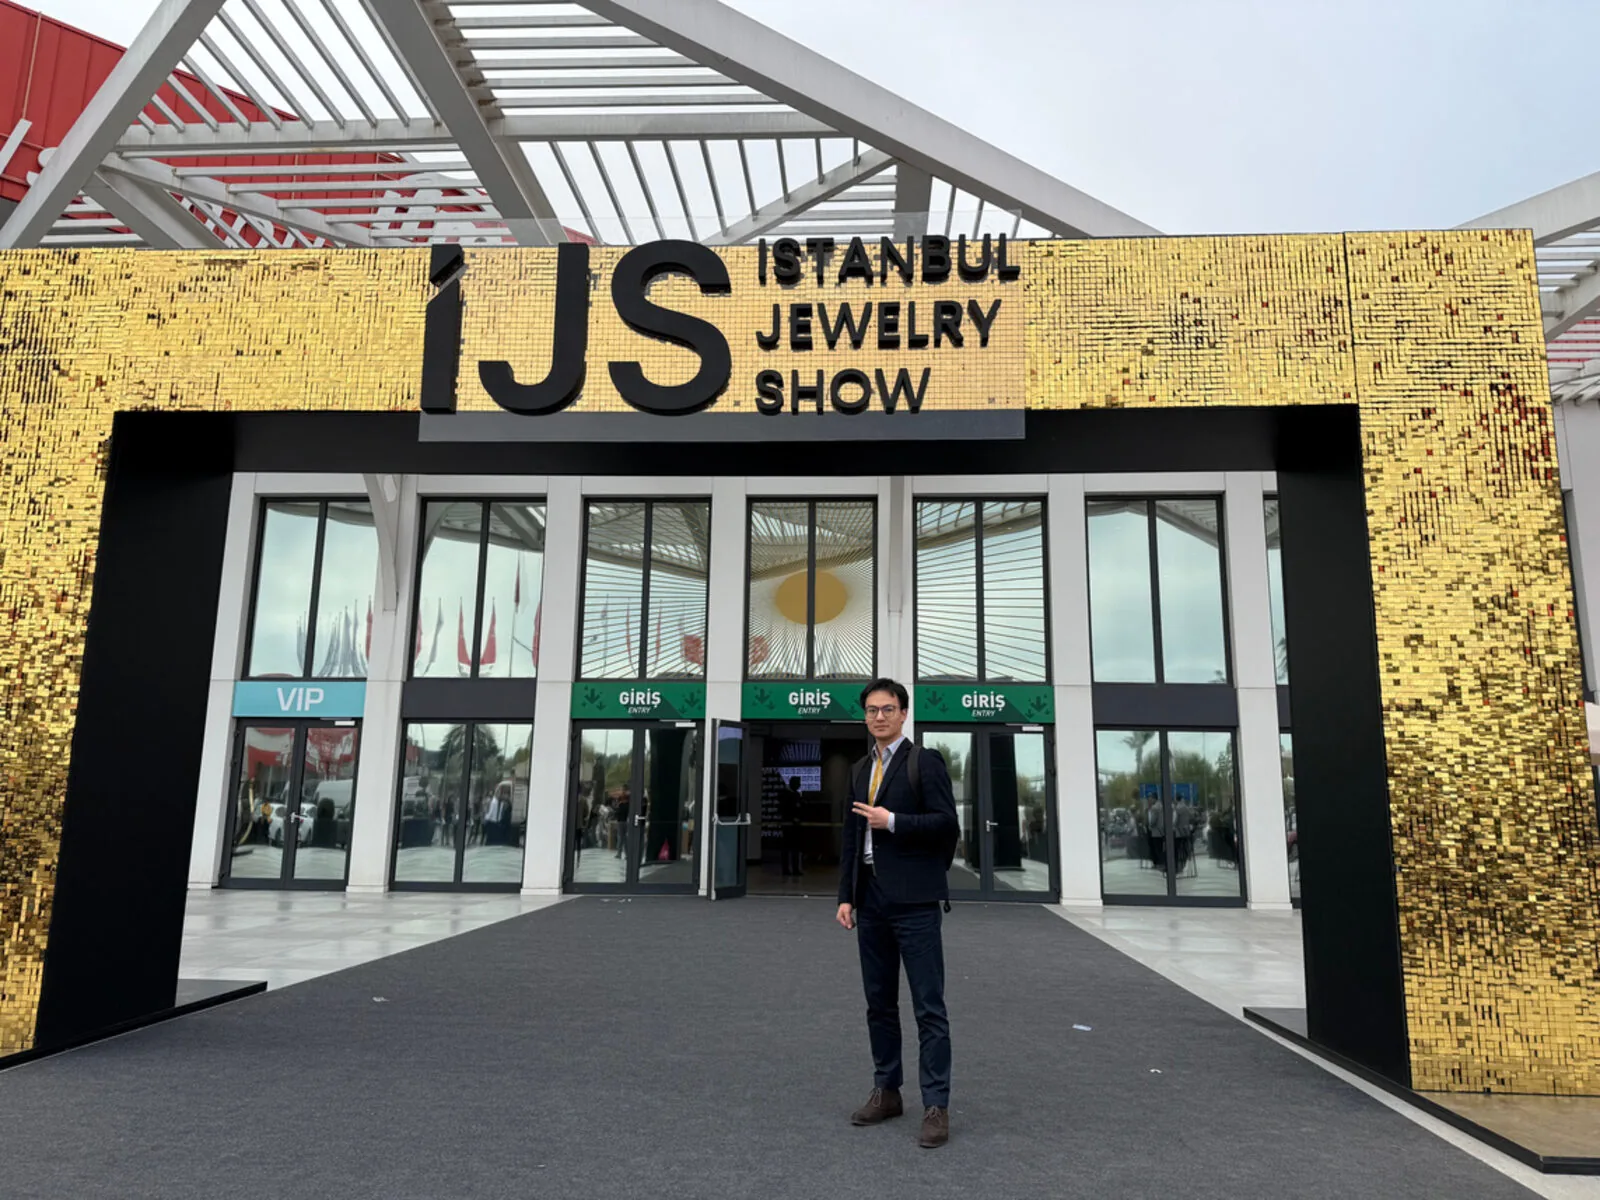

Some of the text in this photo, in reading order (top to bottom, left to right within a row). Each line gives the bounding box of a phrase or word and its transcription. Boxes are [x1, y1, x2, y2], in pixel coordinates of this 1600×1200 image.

[758, 233, 1021, 287] ISTANBUL
[755, 299, 1002, 350] JEWELRY
[755, 368, 931, 416] SHOW
[276, 687, 324, 711] VIP
[619, 688, 661, 708] GİRİŞ
[788, 688, 831, 709] GİRİŞ
[961, 690, 1006, 711] GİRİŞ
[627, 706, 651, 714] ENTRY
[797, 706, 821, 715] ENTRY
[971, 709, 996, 717] ENTRY
